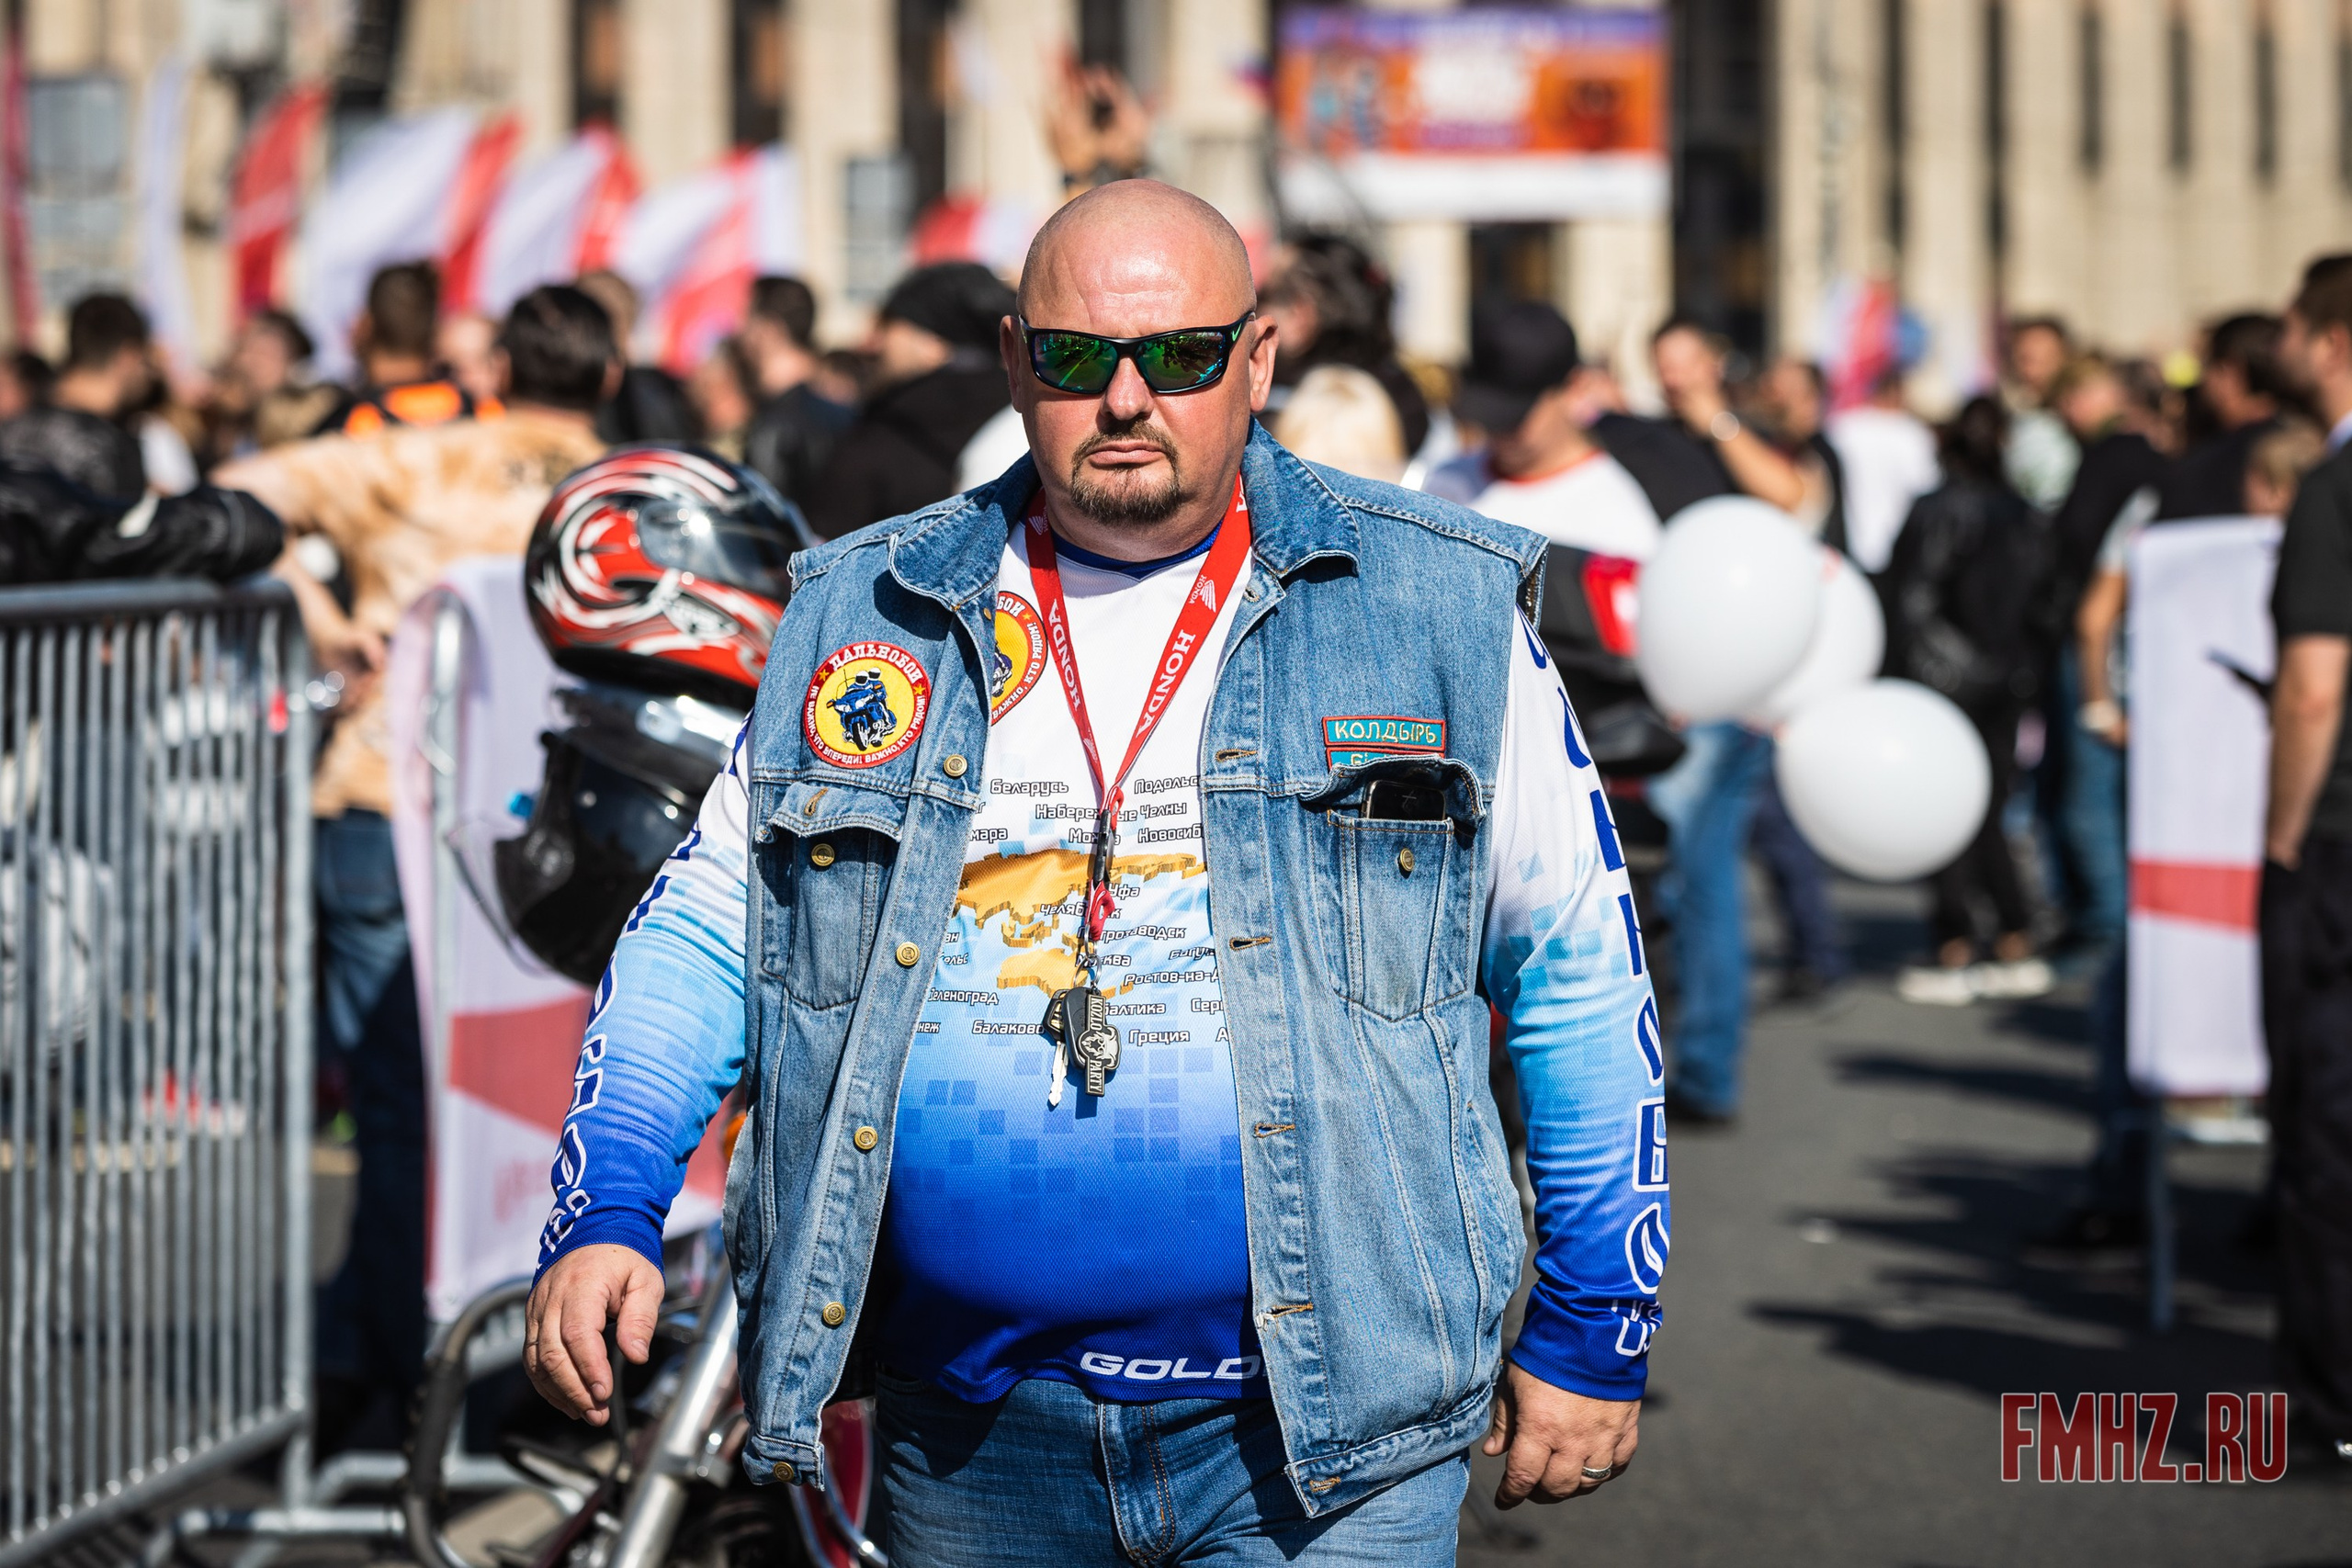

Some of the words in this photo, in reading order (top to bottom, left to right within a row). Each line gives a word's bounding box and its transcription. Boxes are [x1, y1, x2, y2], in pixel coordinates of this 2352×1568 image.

[1048, 598, 1080, 712] HONDA
[1023, 661, 1041, 683] КТО
[1136, 629, 1196, 739] HONDA
[822, 747, 863, 764] ВПЕРЕДИ!
[899, 730, 914, 749] КТО
[911, 694, 925, 731] РЯДОМ!
[1335, 721, 1437, 743] КОЛДЫРЬ
[990, 779, 1069, 796] Беларусь
[1134, 775, 1199, 795] Подольс
[1035, 804, 1138, 822] Набереые
[1140, 803, 1187, 819] Челны
[970, 829, 1009, 843] мара
[1137, 823, 1204, 843] Новосиб
[1108, 883, 1140, 900] Уфа
[1124, 967, 1219, 987] Ростов-на-Д
[1090, 998, 1103, 1031] KOZLO
[1128, 1029, 1190, 1046] Греция
[1090, 1059, 1102, 1092] PARTY
[1080, 1351, 1266, 1381] GOLD
